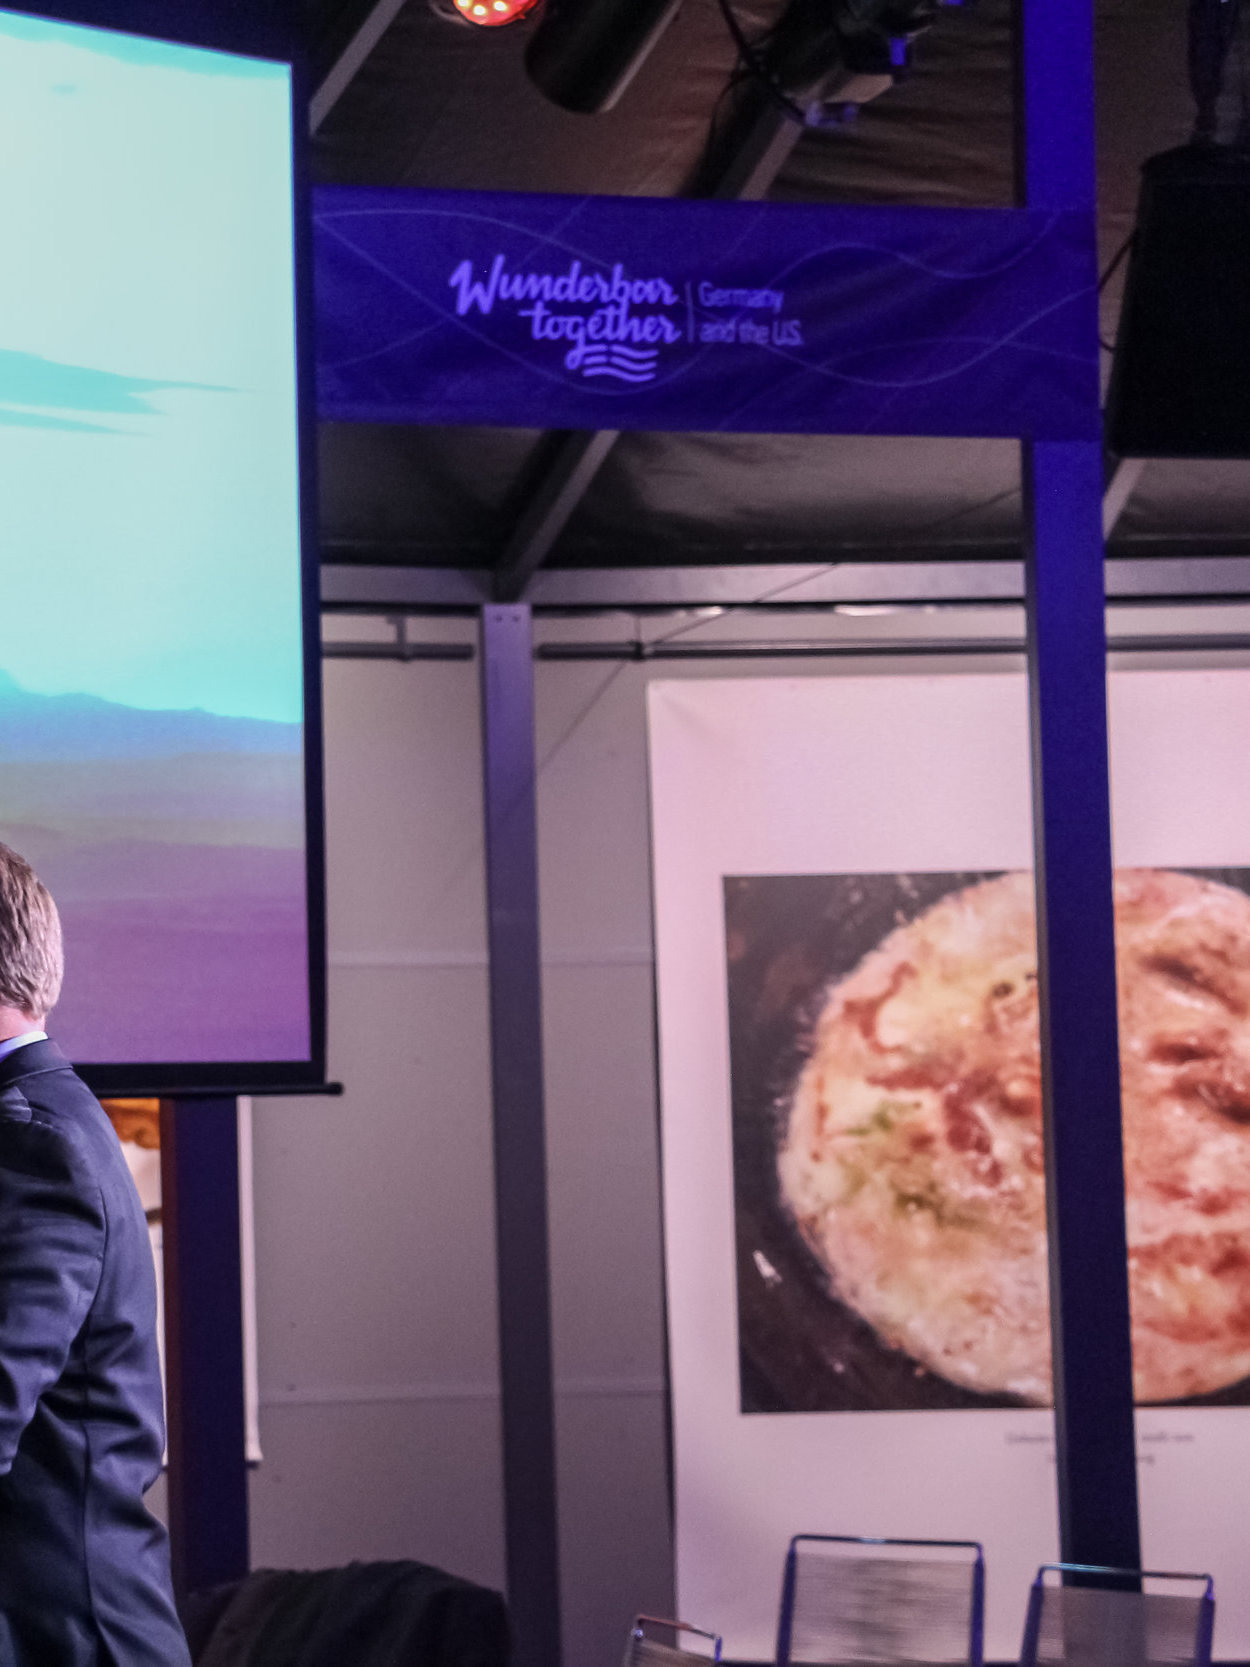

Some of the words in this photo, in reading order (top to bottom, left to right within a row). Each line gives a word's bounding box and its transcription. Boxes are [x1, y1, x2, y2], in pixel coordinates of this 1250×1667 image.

[449, 254, 679, 316] Wunderbar
[698, 281, 784, 315] Germany
[517, 301, 682, 370] together
[700, 319, 735, 343] and
[739, 319, 769, 344] the
